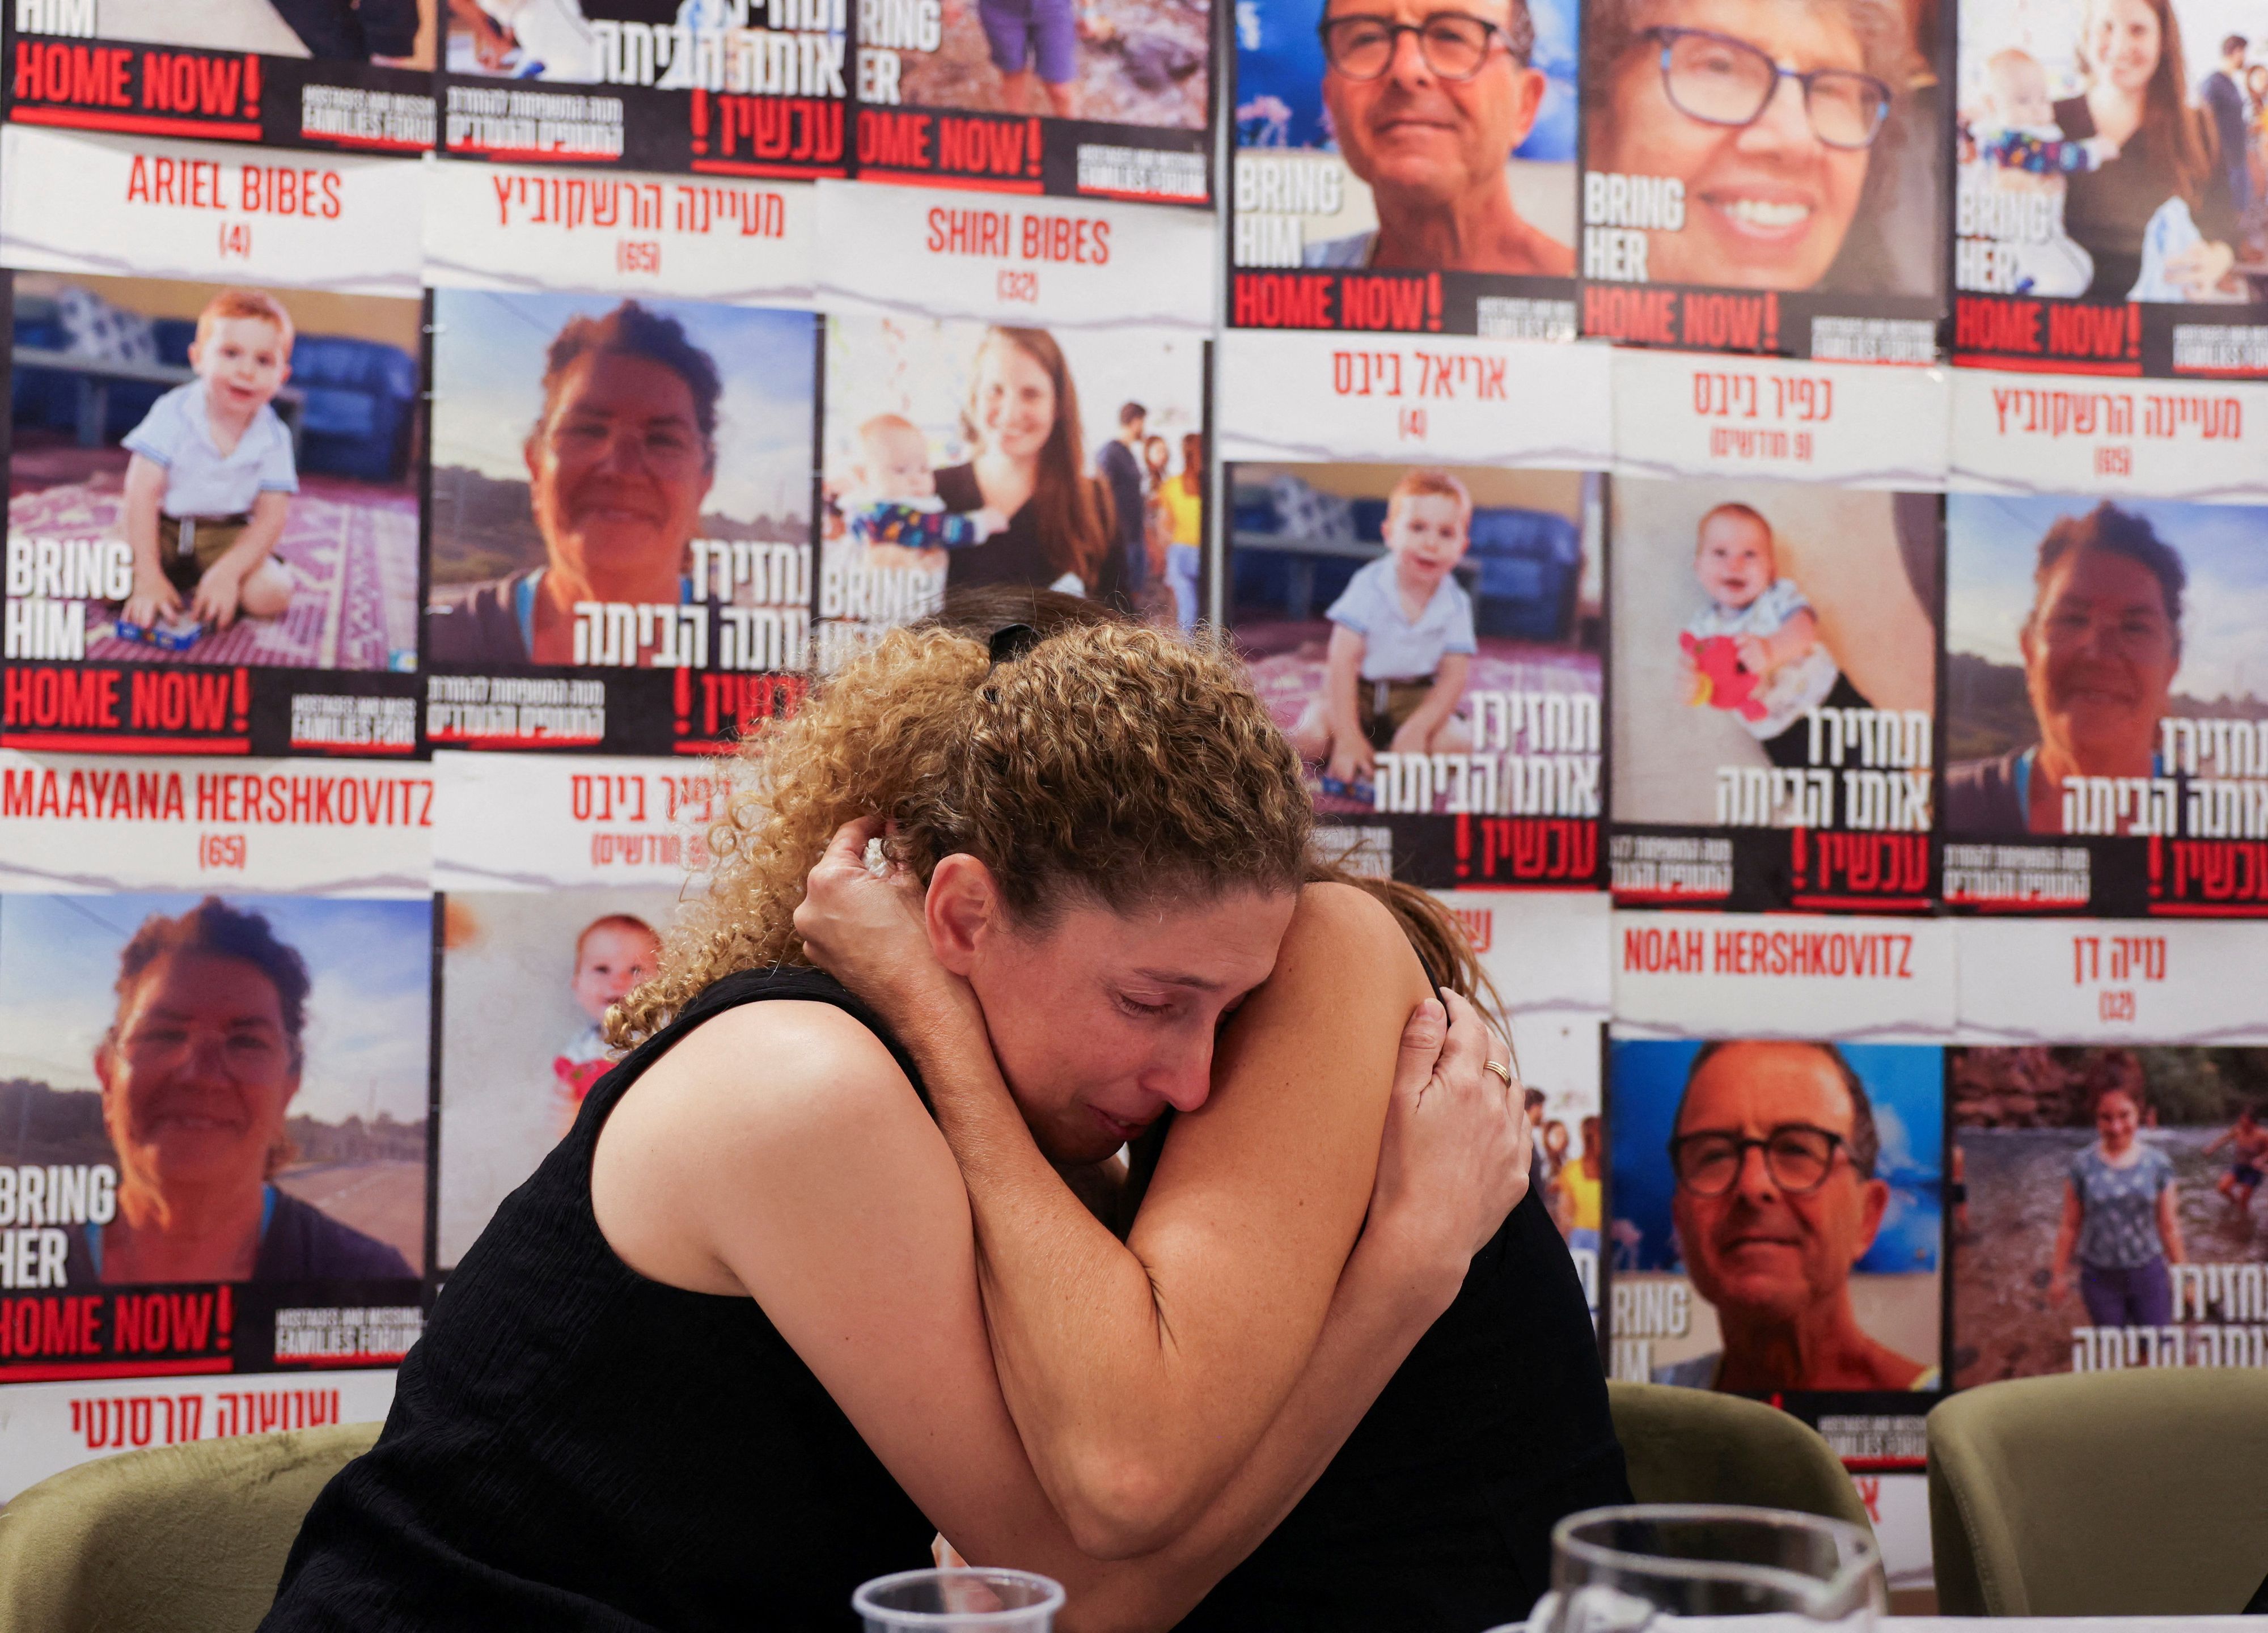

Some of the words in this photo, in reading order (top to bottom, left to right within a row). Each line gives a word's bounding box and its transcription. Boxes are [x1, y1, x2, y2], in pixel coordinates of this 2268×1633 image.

[15, 40, 133, 107] HOME
[143, 50, 262, 119] NOW!
[940, 117, 1043, 178] NOW!
[128, 154, 228, 210] ARIEL
[242, 164, 342, 219] BIBES
[493, 175, 662, 230] הרשקוביץ
[677, 184, 785, 238] מעיינה
[1235, 159, 1342, 213] BRING
[1585, 171, 1685, 231] BRING
[928, 208, 1009, 257] SHIRI
[1022, 215, 1110, 265] BIBES
[1235, 215, 1302, 268] HIM
[1585, 226, 1648, 282] HER
[1234, 275, 1334, 329] HOME
[1342, 273, 1443, 332] NOW!
[1585, 286, 1676, 342] HOME
[1684, 291, 1779, 350] NOW!
[1957, 297, 2041, 353] HOME
[2049, 302, 2142, 358] NOW!
[1416, 351, 1508, 400] אריאל
[1770, 375, 1832, 421] כפיר
[5, 538, 134, 601] BRING
[5, 599, 86, 660] HIM
[574, 602, 709, 667] הביתה
[3, 667, 121, 728] HOME
[132, 667, 250, 733] NOW!
[1471, 692, 1600, 751] תחזירו
[1802, 707, 1932, 768] תחזירו
[2, 769, 185, 823] MAAYANA
[197, 773, 434, 826] HERSHKOVITZ
[1374, 753, 1498, 814] הביתה
[1506, 755, 1602, 816] אותו
[1716, 766, 1835, 828] הביתה
[1842, 769, 1932, 831] אותו
[2062, 776, 2179, 836] הביתה
[199, 834, 246, 872] (65)
[1624, 929, 1703, 973] NOAH
[1713, 931, 1913, 978] HERSHKOVITZ
[0, 1164, 117, 1225] BRING
[112, 1285, 232, 1353] NOW!
